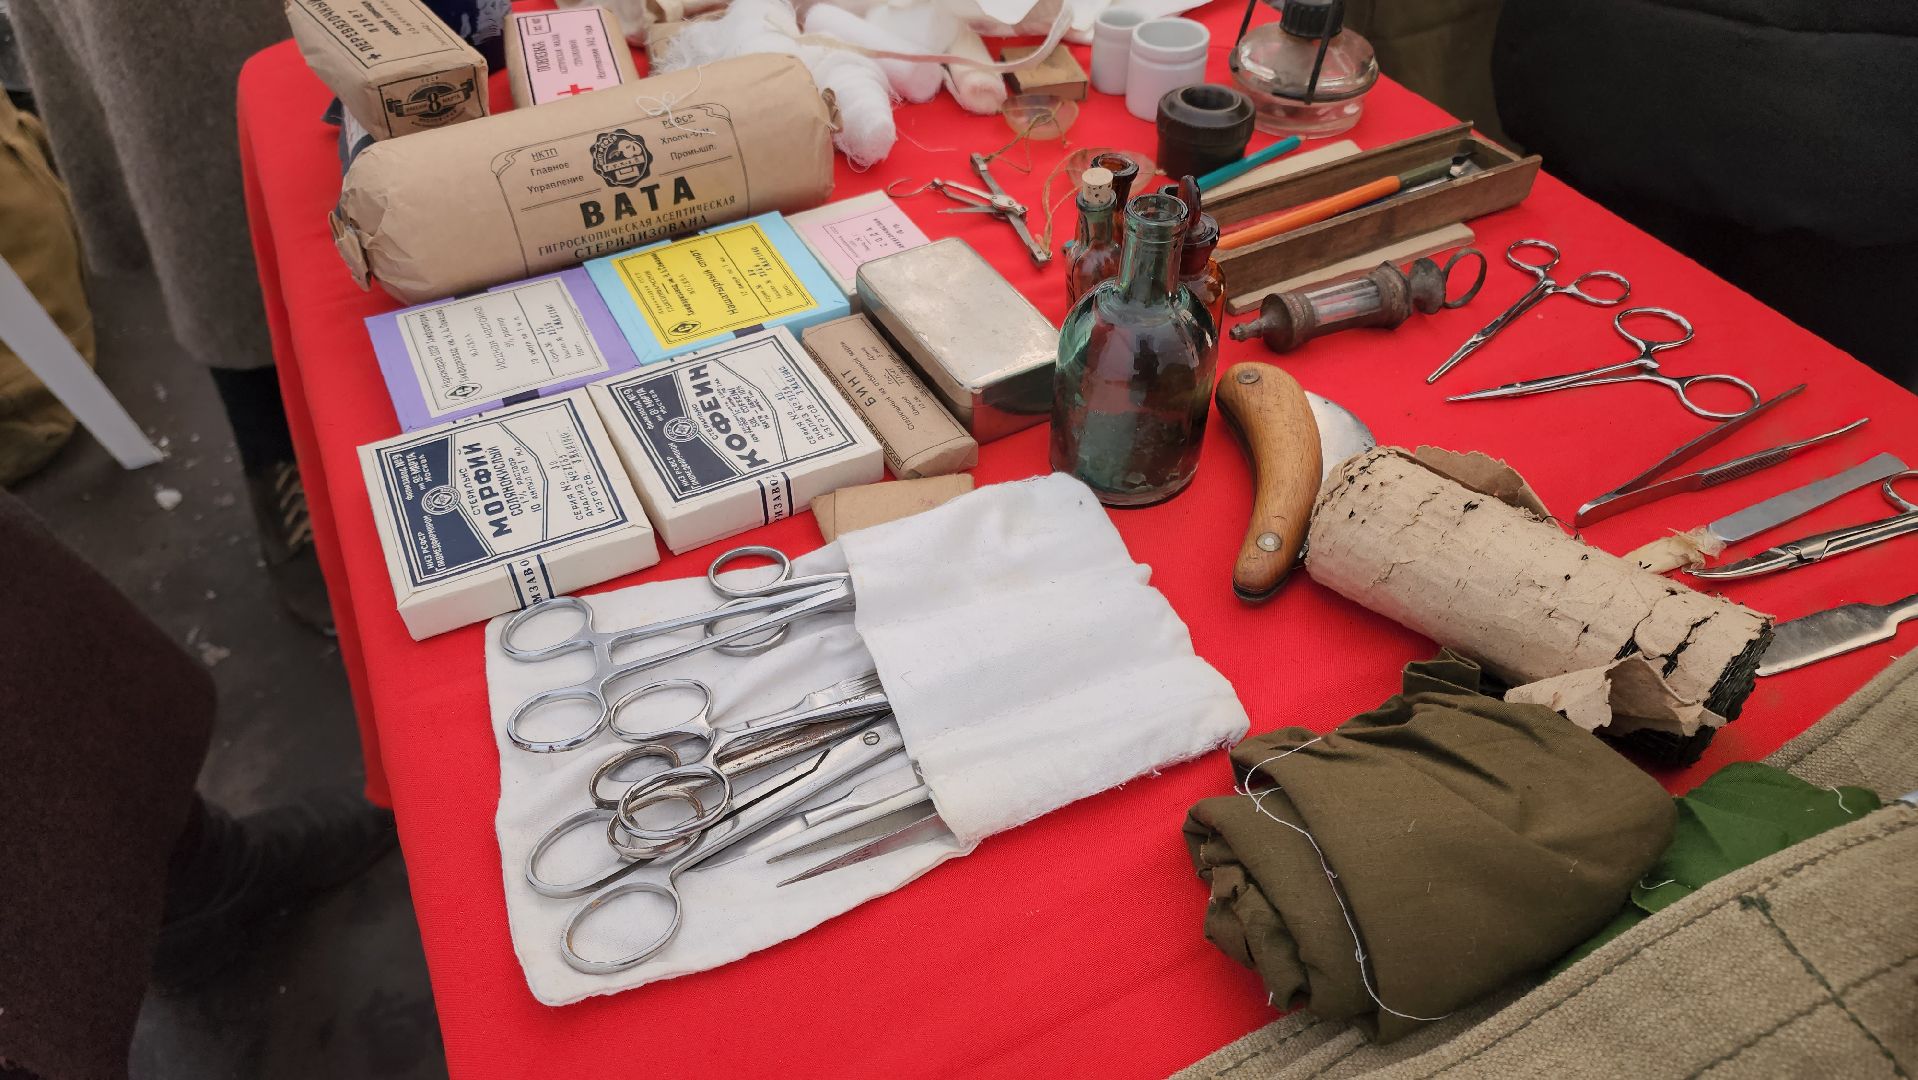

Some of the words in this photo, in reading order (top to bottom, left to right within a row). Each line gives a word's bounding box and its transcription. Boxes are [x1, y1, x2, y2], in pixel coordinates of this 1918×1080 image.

[529, 161, 569, 176] Главное
[526, 174, 584, 194] Управление
[578, 175, 695, 228] ВАТА
[655, 195, 735, 224] АСЕПТИЧЕСКАЯ
[573, 214, 708, 259] СТЕРИЛИЗОВАНА
[701, 268, 740, 315] Нашатырный
[840, 369, 877, 407] БИНТ
[688, 363, 770, 469] КОФЕИН
[691, 403, 718, 440] СТЕРИЛЬНО
[800, 412, 825, 440] АНАЛИЗ
[795, 421, 817, 444] СЕРИЯ
[486, 445, 523, 516] СОЛЯНОКИСЛЫЙ
[507, 457, 523, 485] РАСТВОР
[559, 480, 572, 491] №
[567, 470, 579, 481] №
[458, 442, 512, 538] МОРФИЙ
[458, 468, 480, 515] СТЕРИЛЬНО
[574, 483, 594, 516] АНАЛИЗ
[530, 503, 542, 512] 10
[566, 493, 583, 520] СЕРИЯ
[417, 531, 429, 553] РСФСР
